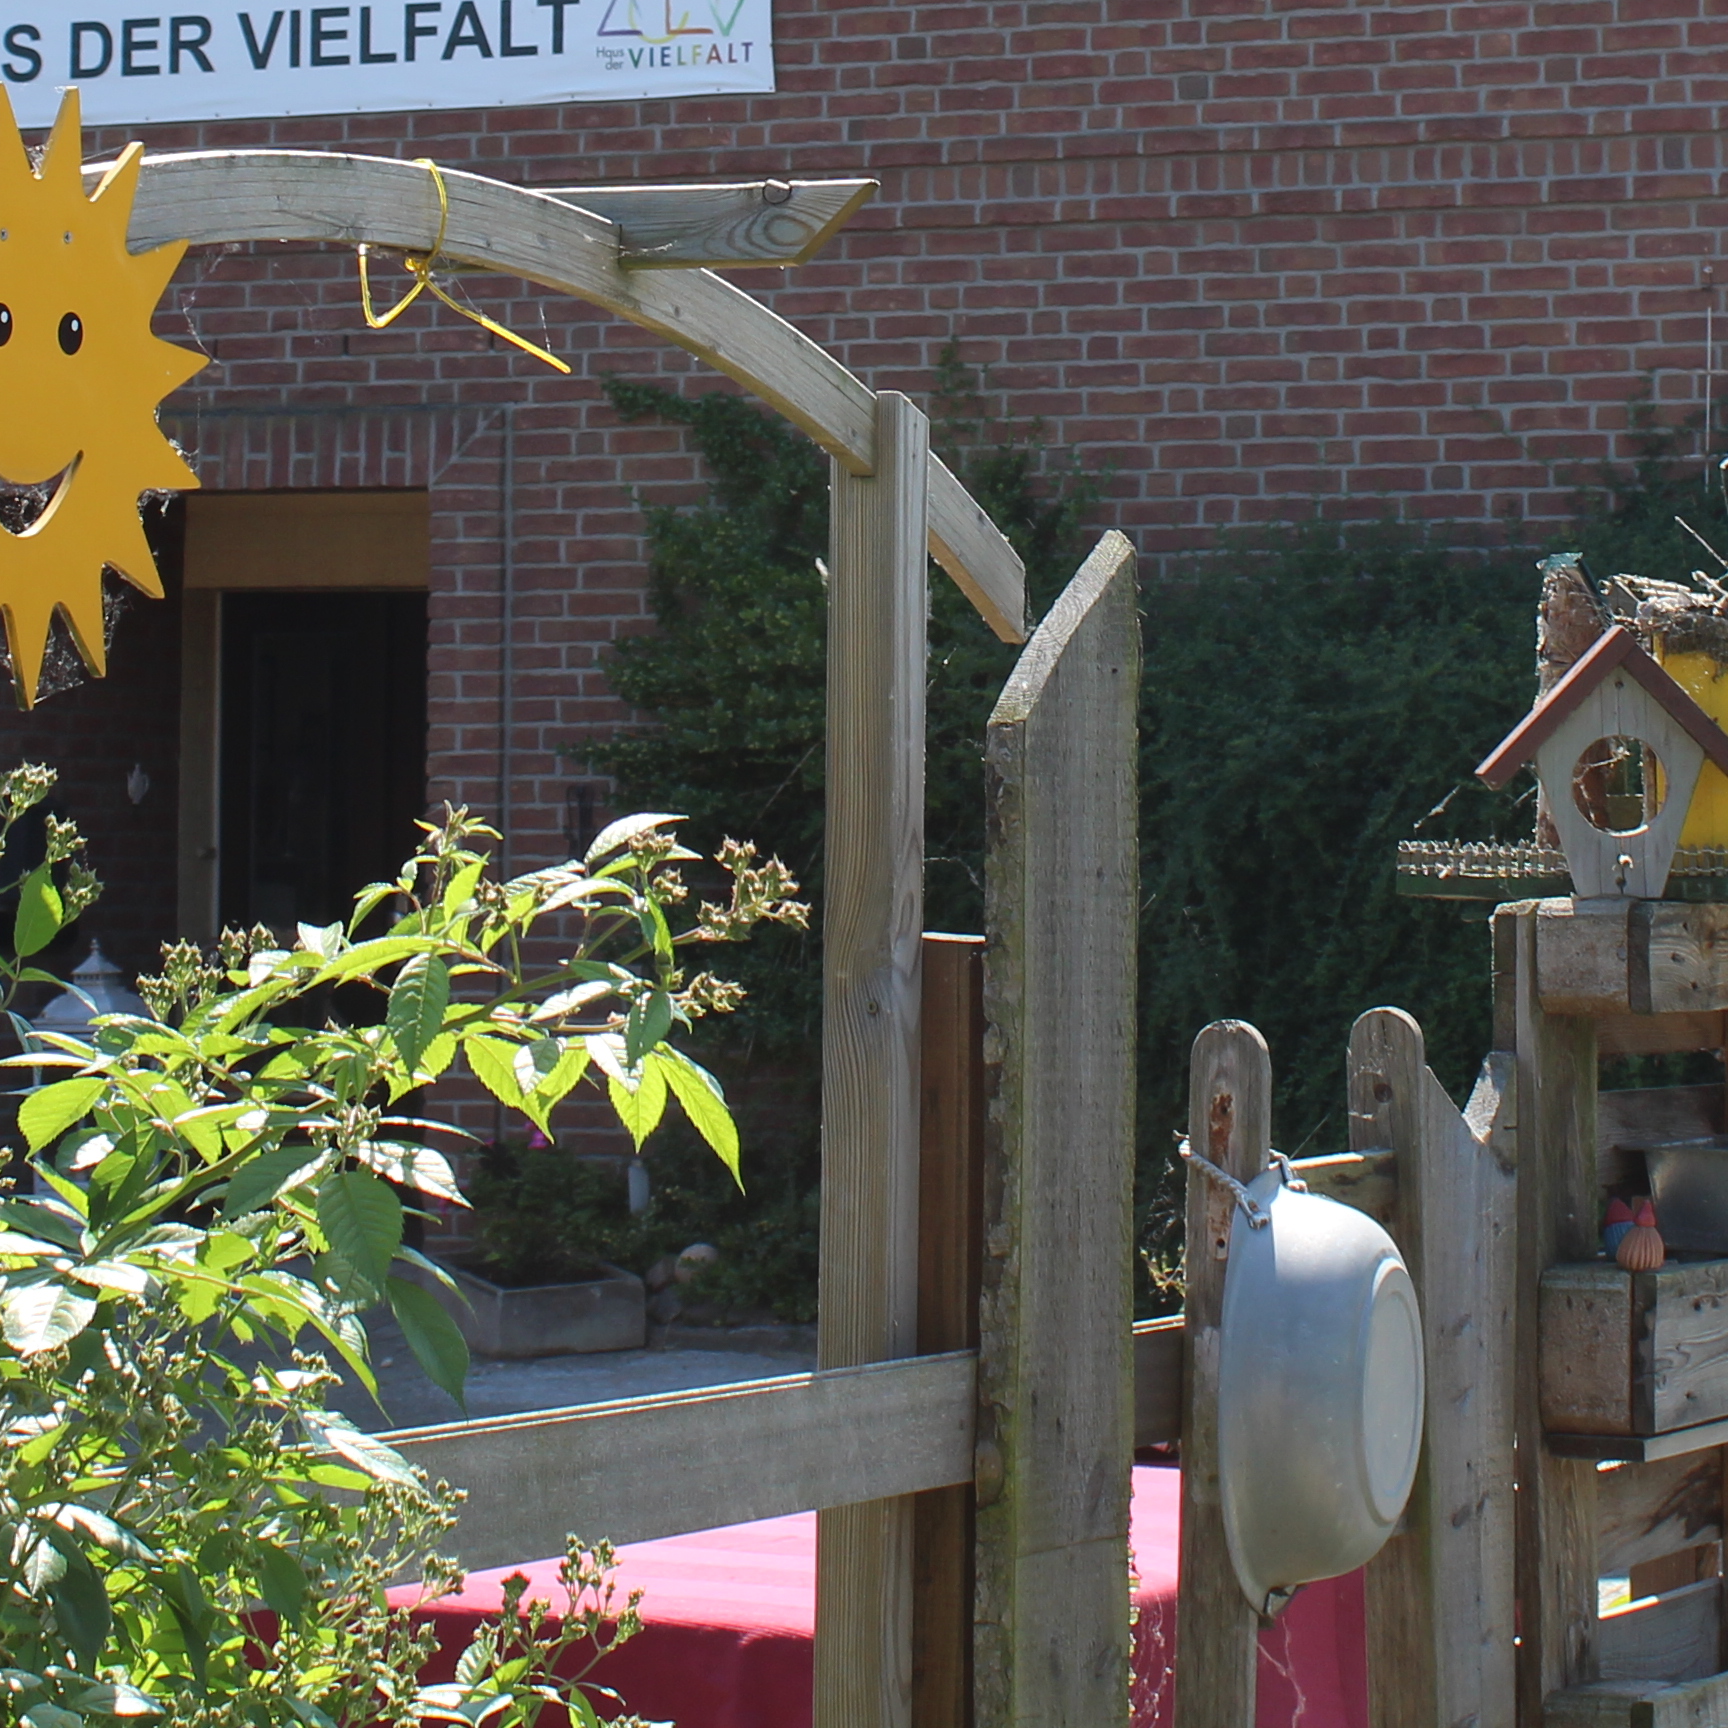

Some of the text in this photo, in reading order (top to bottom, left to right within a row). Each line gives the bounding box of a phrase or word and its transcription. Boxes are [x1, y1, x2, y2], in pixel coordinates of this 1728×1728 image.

[69, 15, 215, 79] DER
[596, 47, 624, 58] Haus
[605, 42, 753, 70] der VIELFALT
